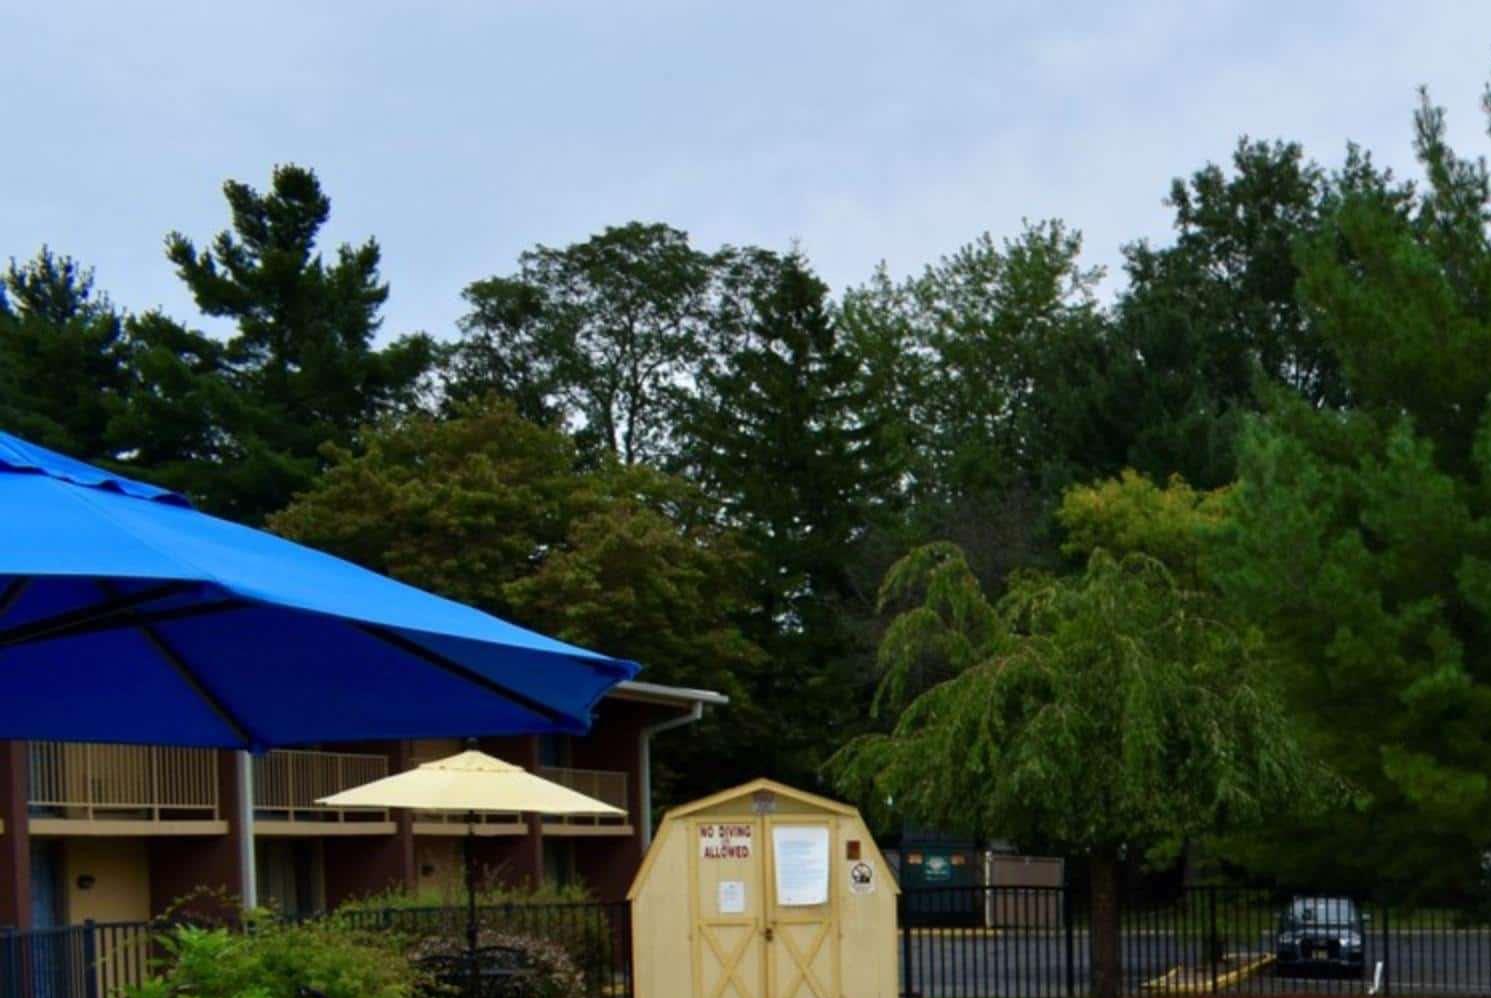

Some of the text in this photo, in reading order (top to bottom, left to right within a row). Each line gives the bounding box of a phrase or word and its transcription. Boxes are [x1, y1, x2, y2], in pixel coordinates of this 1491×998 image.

[701, 825, 751, 838] NO DIVING
[704, 846, 749, 859] ALLOWED
